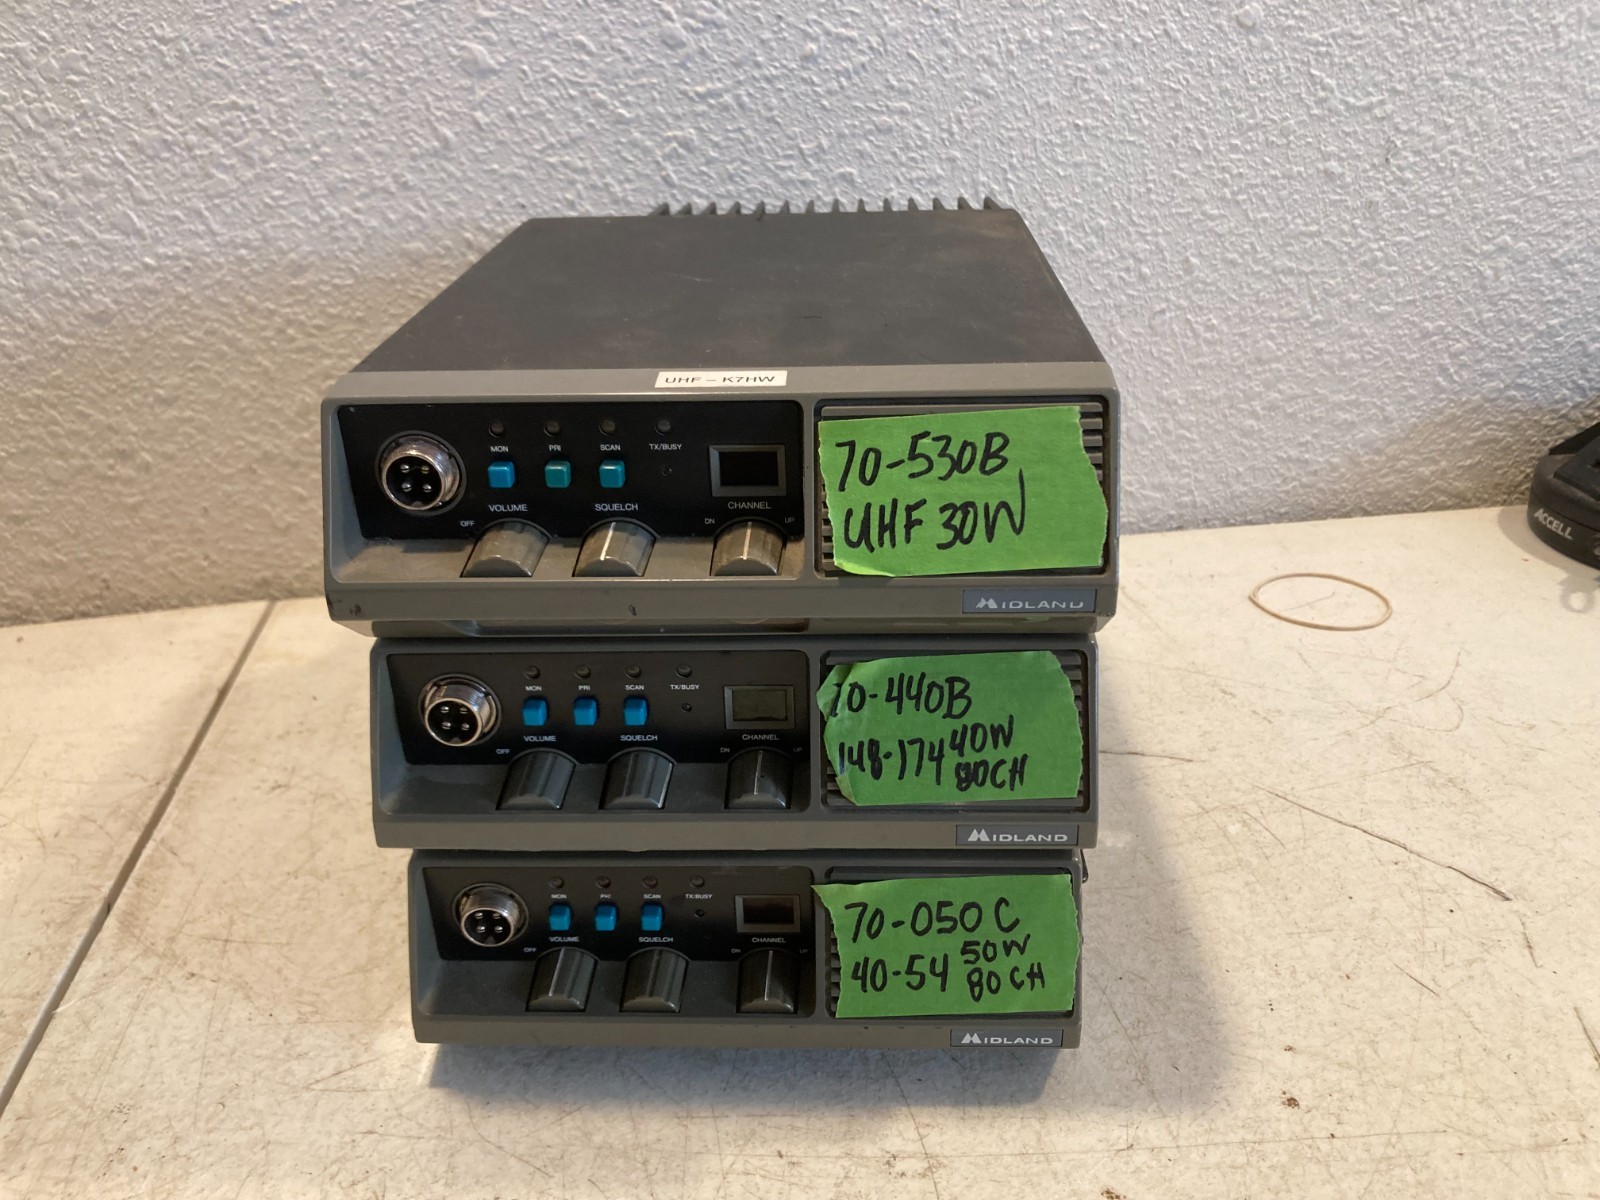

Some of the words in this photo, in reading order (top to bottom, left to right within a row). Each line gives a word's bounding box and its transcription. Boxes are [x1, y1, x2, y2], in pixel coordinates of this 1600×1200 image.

[665, 376, 702, 384] UHF
[722, 375, 776, 384] K7HW
[490, 445, 509, 453] MON
[548, 444, 562, 452] PRI
[649, 443, 683, 451] TX/BUSY
[835, 430, 1010, 492] 70-530B
[488, 503, 528, 512] VOLUME
[594, 502, 639, 511] SQUELCH
[727, 501, 772, 510] CHANNEL
[704, 517, 715, 525] DN
[784, 516, 795, 524] UP
[1534, 508, 1574, 541] ACCELL
[843, 497, 928, 553] UHF
[619, 734, 658, 742] SQUELCH
[741, 733, 780, 741] CHANNEL
[949, 714, 1015, 757] 40W
[838, 737, 945, 786] 148-174
[967, 828, 1069, 842] MIDLAND
[751, 936, 786, 944] CHANNEL
[851, 953, 949, 993] 40-54
[960, 1032, 1053, 1045] MIDLAND
